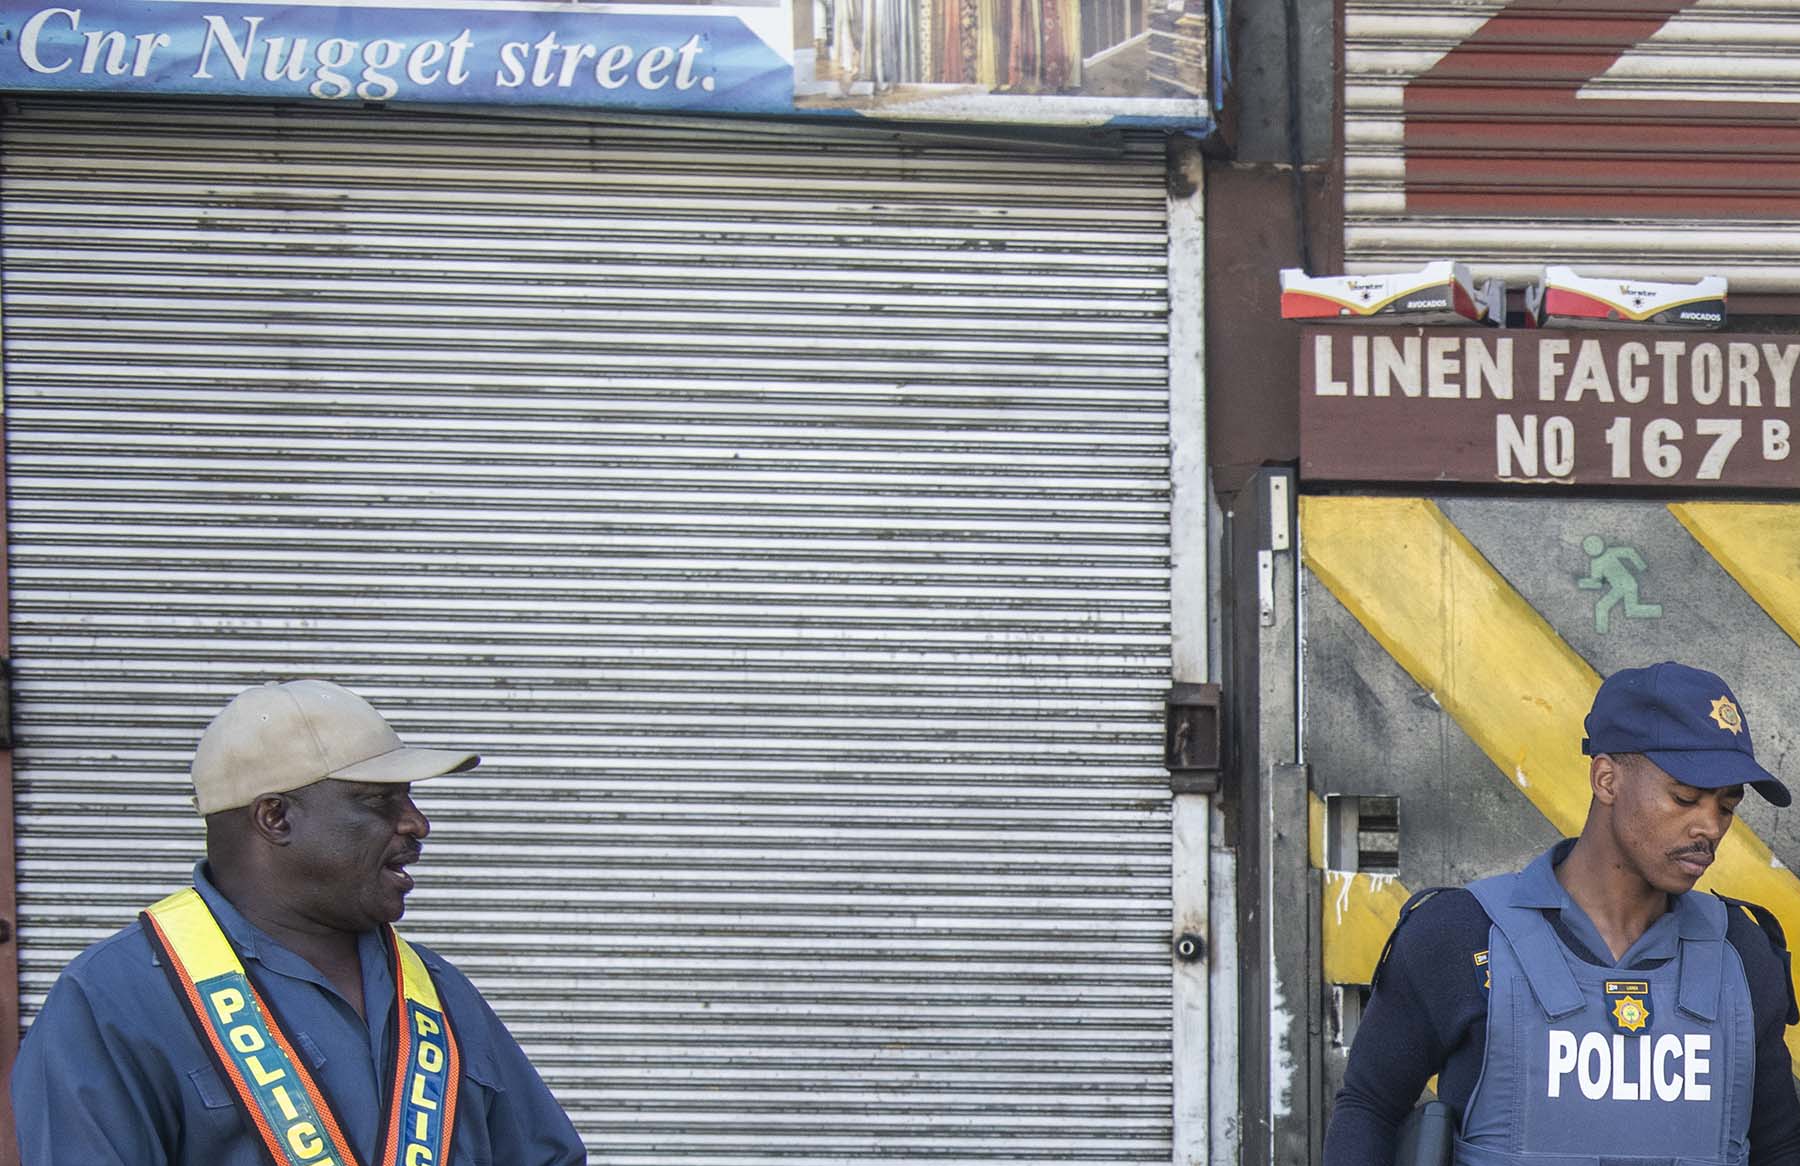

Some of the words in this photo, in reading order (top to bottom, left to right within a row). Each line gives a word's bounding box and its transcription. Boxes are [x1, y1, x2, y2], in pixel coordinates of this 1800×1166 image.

[19, 8, 171, 78] Cnr
[193, 16, 474, 100] Nugget
[497, 29, 716, 92] street.
[1407, 299, 1447, 309] AVOCADOS
[1680, 311, 1721, 322] AVOCADOS
[1315, 335, 1513, 399] LINEN
[1496, 414, 1576, 480] NO
[1548, 1030, 1711, 1102] POLICE
